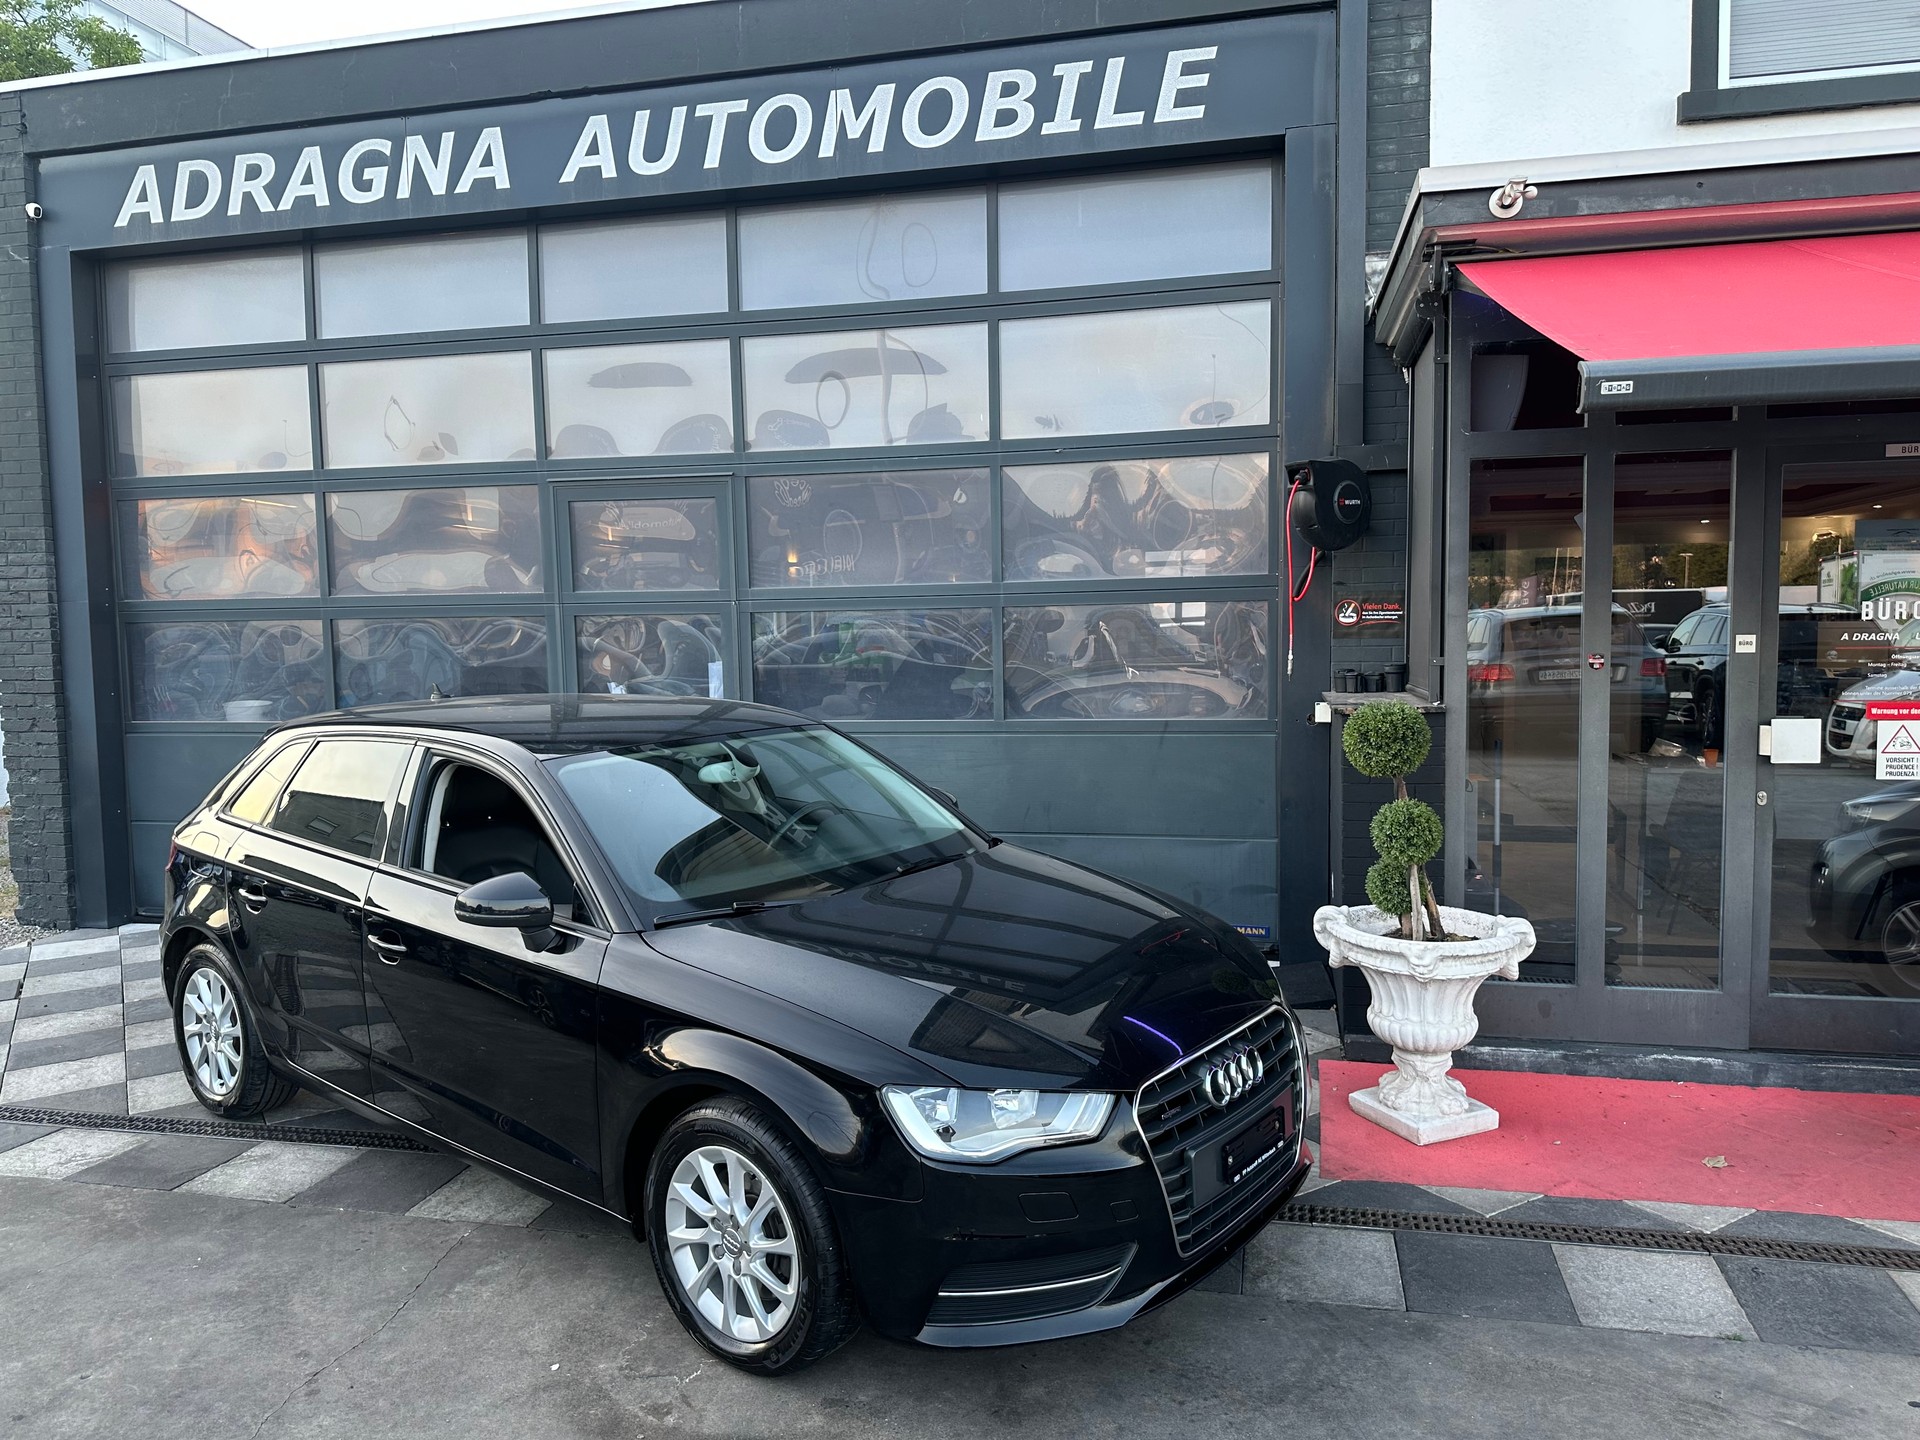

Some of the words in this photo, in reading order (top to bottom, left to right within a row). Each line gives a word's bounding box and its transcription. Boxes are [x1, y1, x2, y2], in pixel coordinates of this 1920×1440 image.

[113, 126, 511, 228] ADRAGNA
[559, 46, 1218, 183] AUTOMOBILE
[1852, 632, 1900, 641] DRAGNA
[1871, 707, 1898, 715] Warnung
[1234, 926, 1266, 935] MANN
